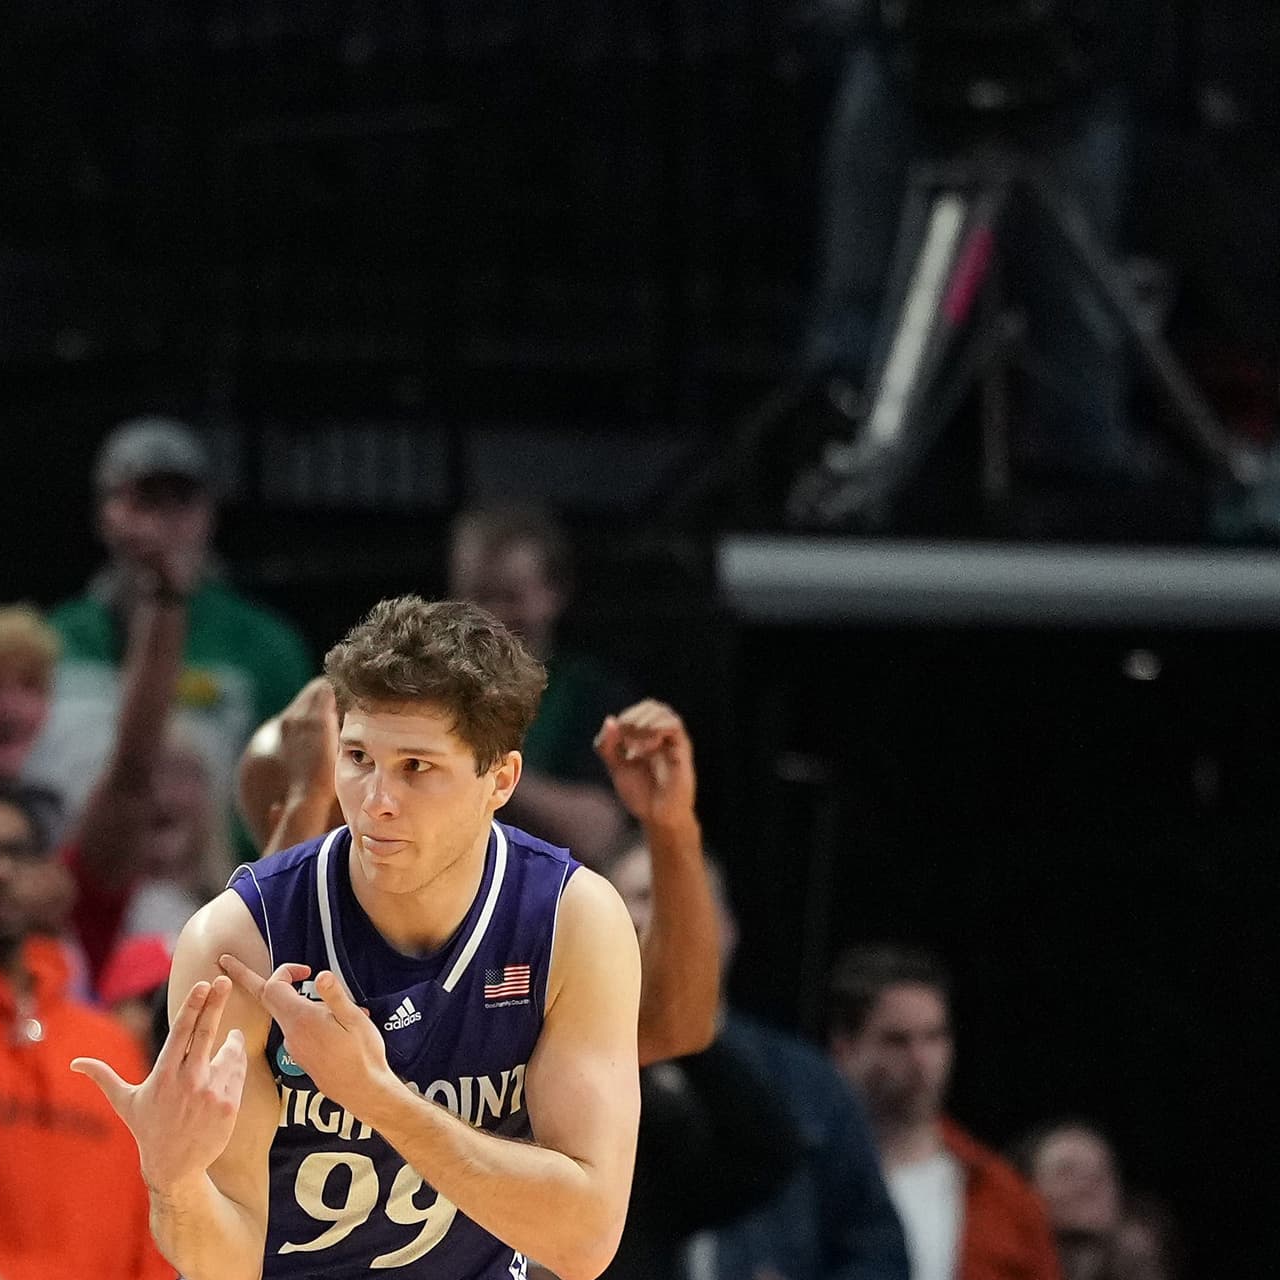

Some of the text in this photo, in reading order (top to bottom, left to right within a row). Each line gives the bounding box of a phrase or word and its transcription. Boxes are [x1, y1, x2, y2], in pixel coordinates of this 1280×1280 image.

[384, 1011, 422, 1031] adidas
[406, 1063, 526, 1128] OINT
[278, 1152, 458, 1269] 99
